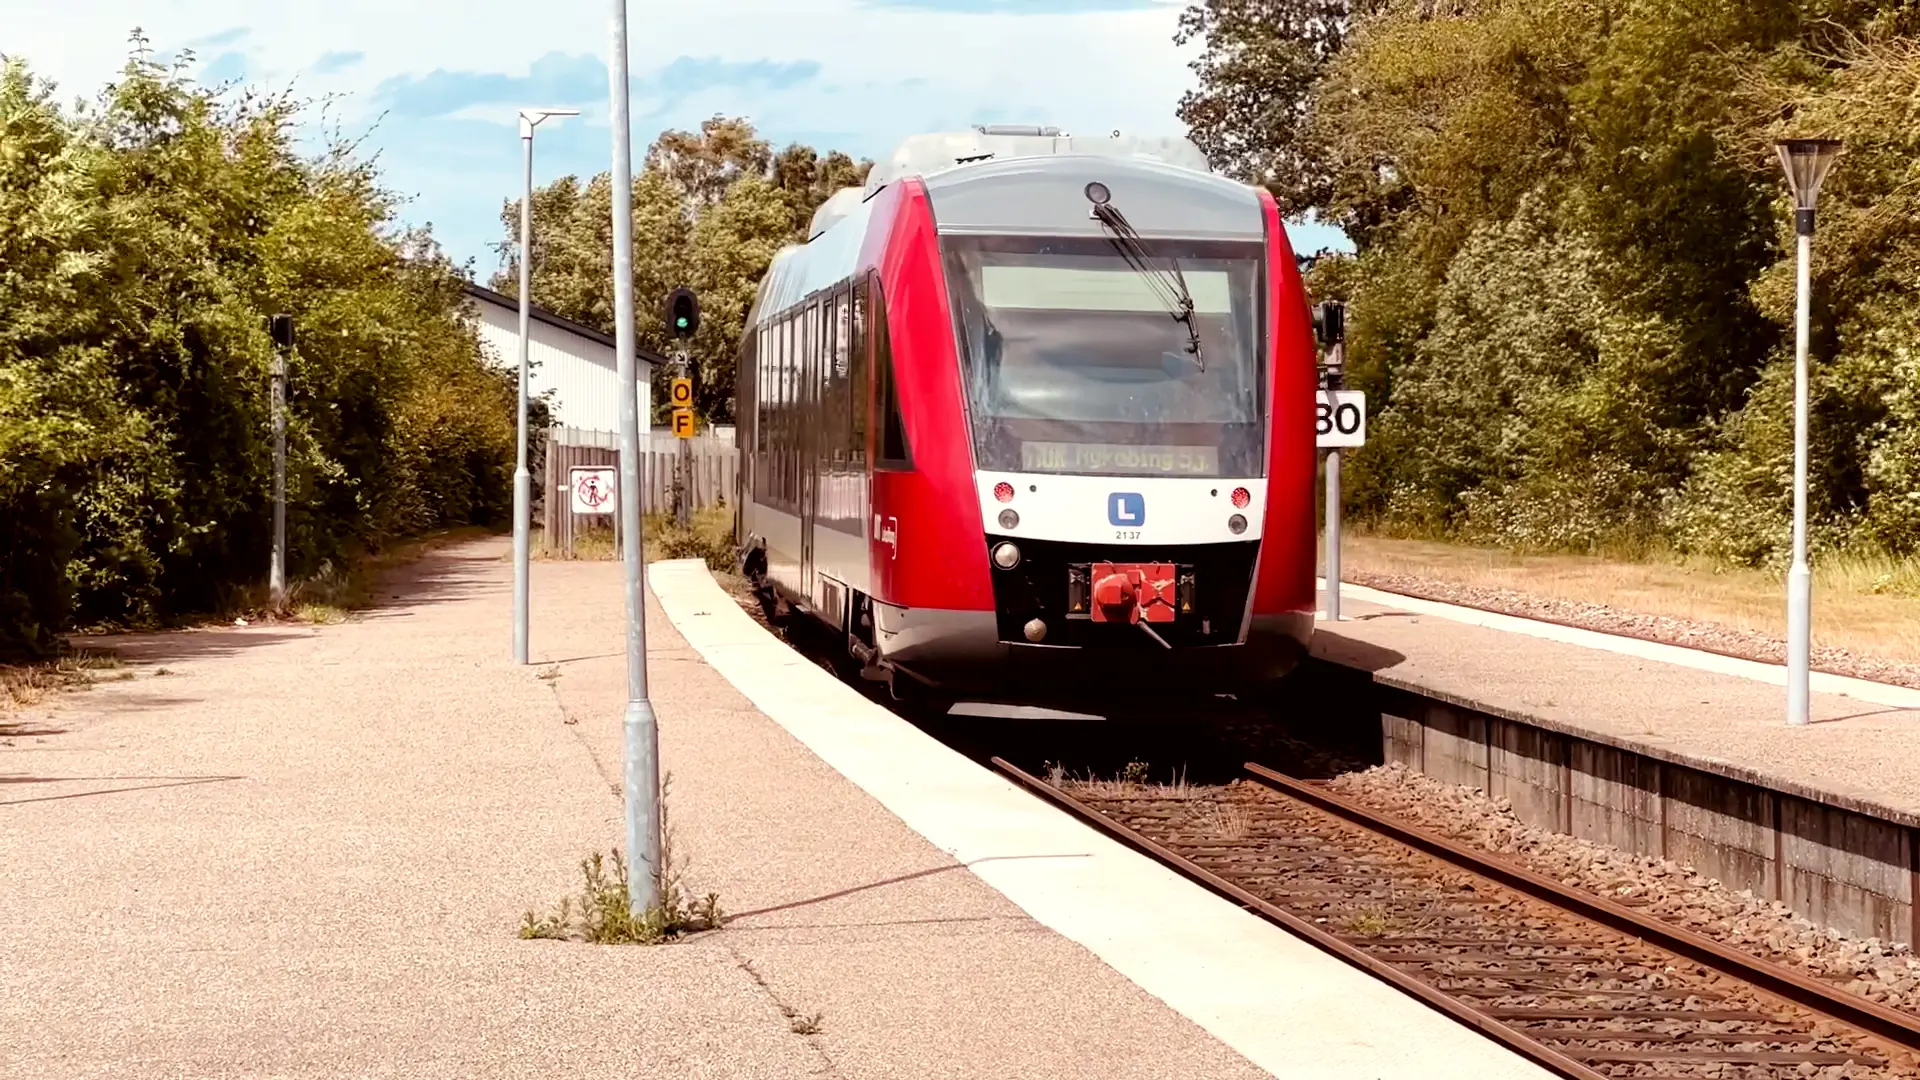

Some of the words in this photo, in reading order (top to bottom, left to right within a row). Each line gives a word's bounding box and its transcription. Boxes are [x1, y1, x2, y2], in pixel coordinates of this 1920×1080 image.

[674, 383, 689, 401] O
[677, 415, 689, 433] F
[1316, 403, 1361, 435] 80
[1118, 499, 1136, 520] L
[1115, 531, 1141, 540] 2137
